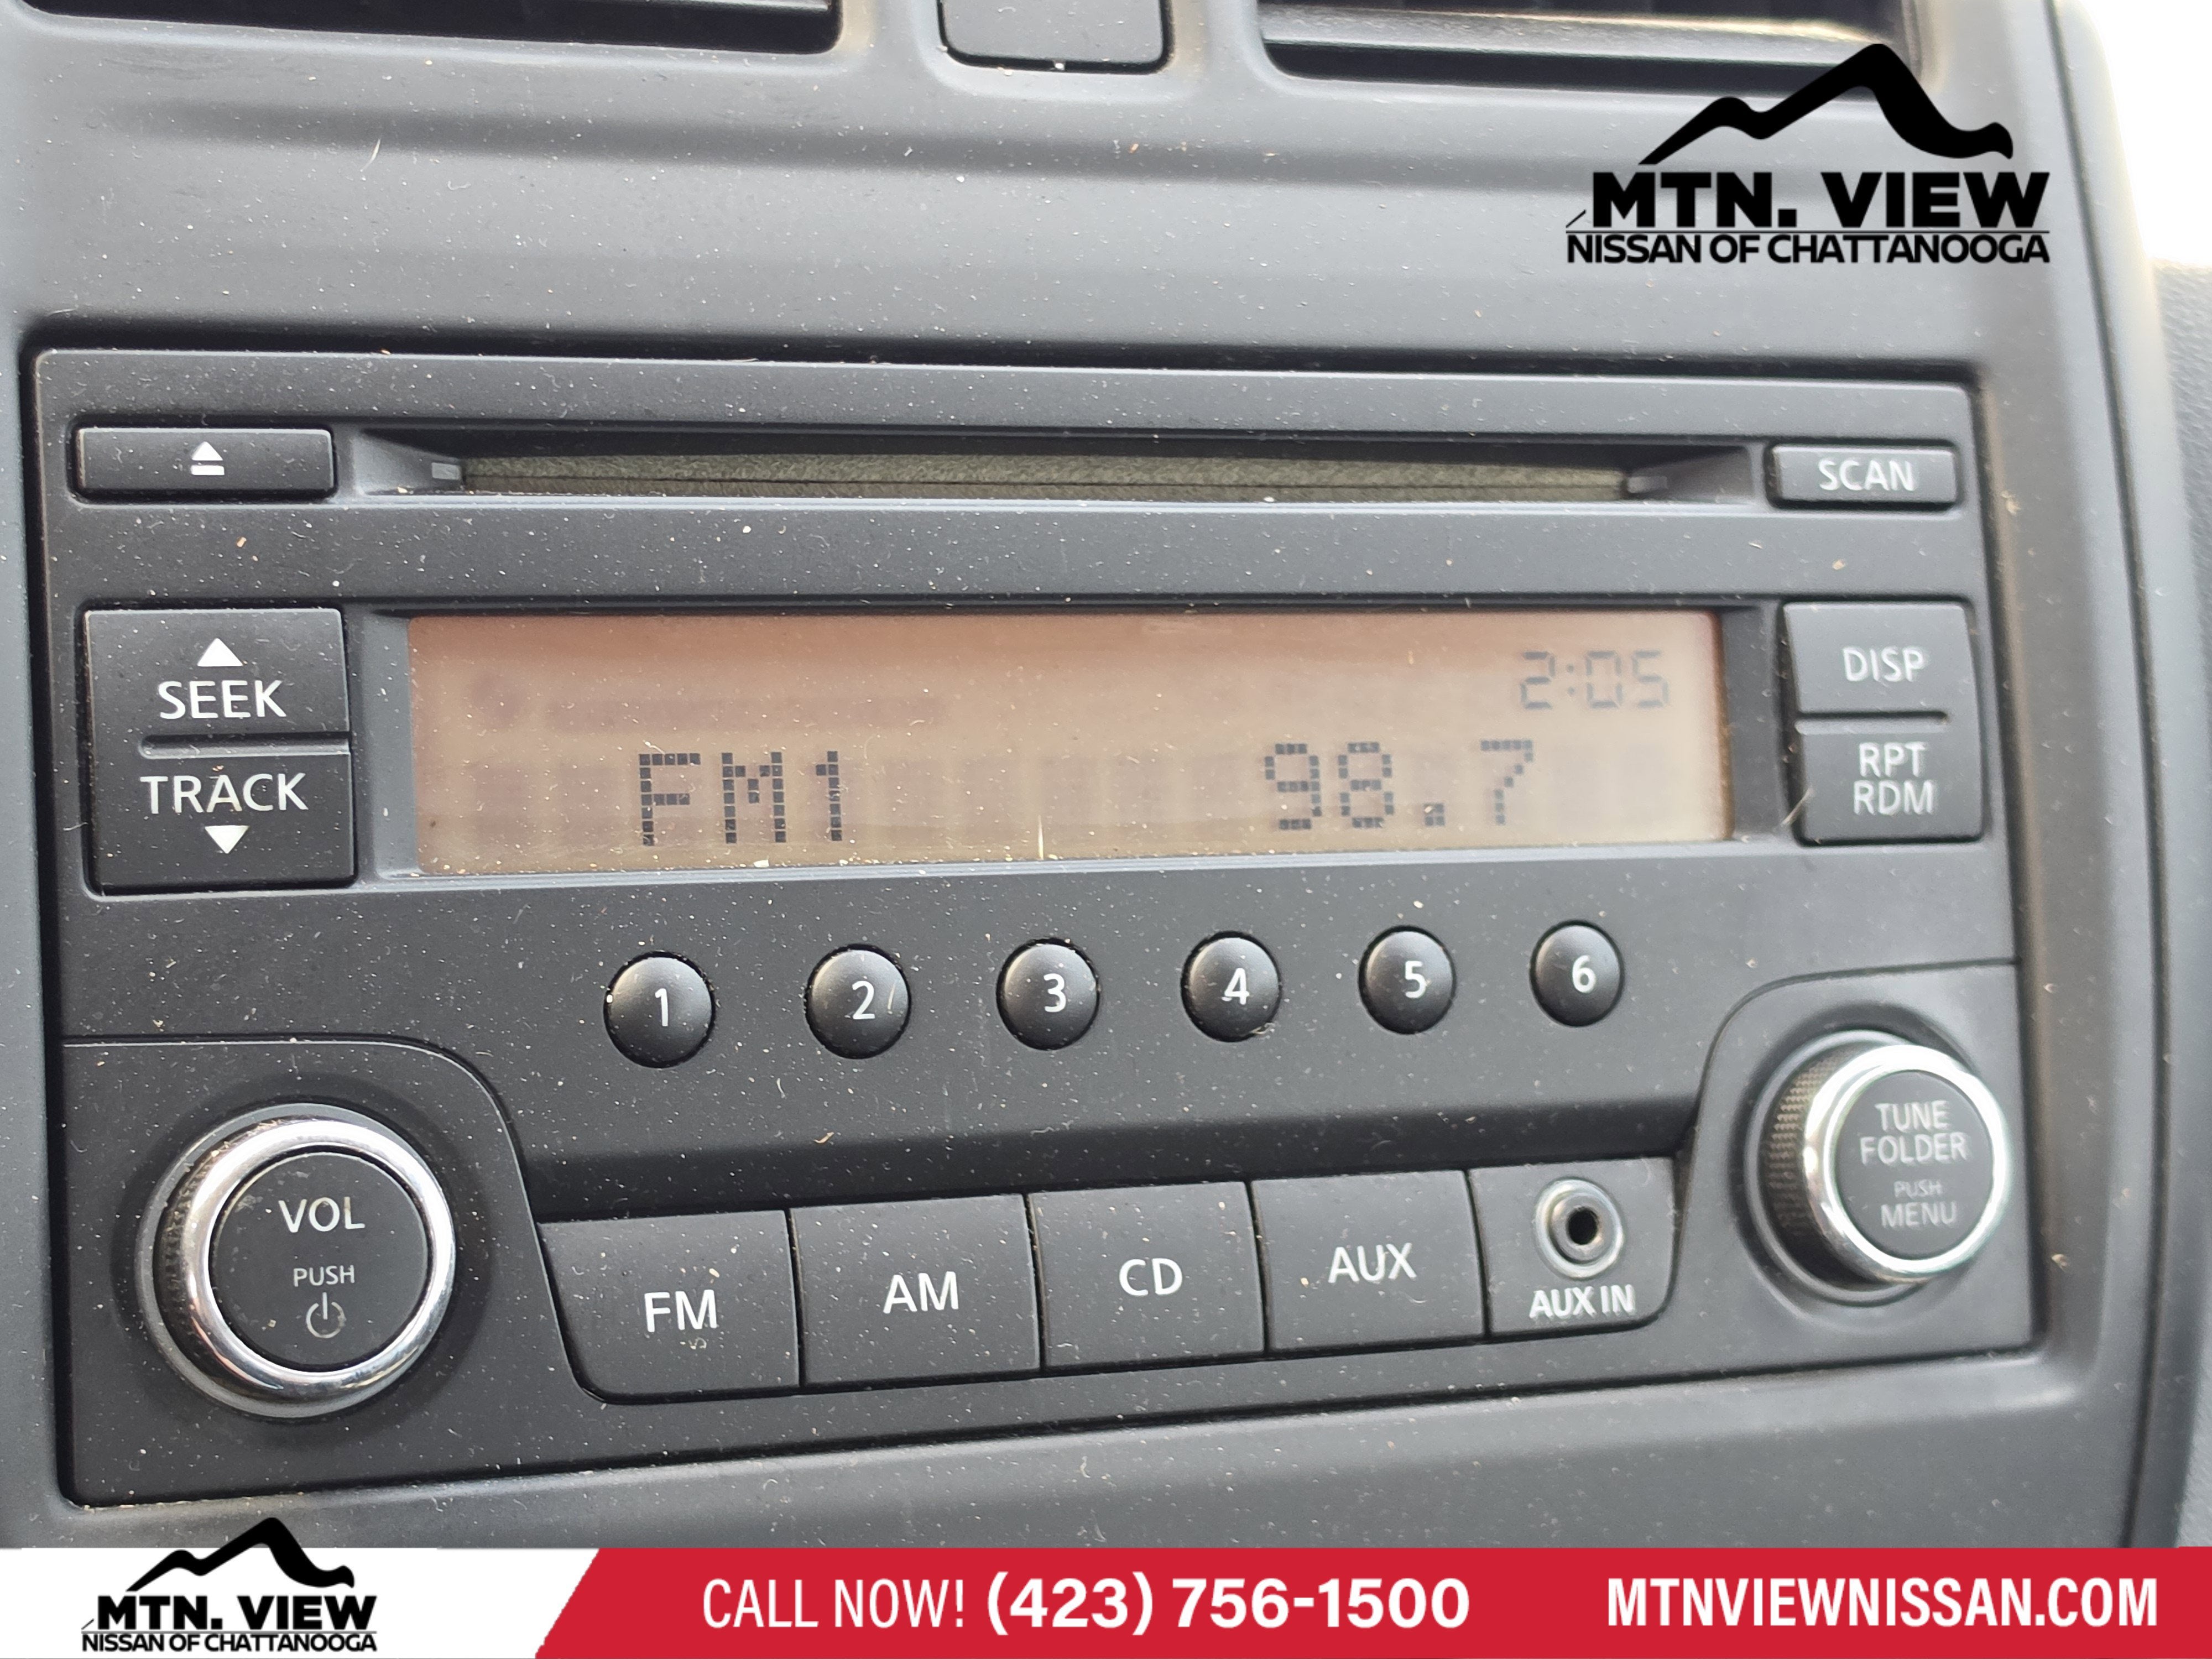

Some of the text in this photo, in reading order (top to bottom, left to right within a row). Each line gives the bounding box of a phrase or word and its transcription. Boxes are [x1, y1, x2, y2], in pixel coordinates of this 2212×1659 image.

[1818, 460, 1916, 491] SCAN
[1520, 651, 1668, 709] 2:05
[1843, 646, 1928, 683] DISP
[157, 680, 287, 719] SEEK
[1859, 742, 1927, 777] RPT
[140, 773, 309, 815] TRACK
[639, 739, 1533, 846] FM1 98.7
[1854, 781, 1934, 815] RDM
[1043, 973, 1066, 1013] 3
[1223, 967, 1249, 1005] 4
[1404, 961, 1428, 999] 5
[1572, 955, 1596, 993] 6
[655, 988, 669, 1027] 1
[852, 980, 875, 1020] 2
[1875, 1100, 1949, 1132] TUNE
[1860, 1132, 1968, 1165] FOLDER
[1894, 1180, 1942, 1198] PUSH
[279, 1196, 366, 1233] VOL
[1881, 1201, 1957, 1227] MENU
[293, 1265, 355, 1287] PUSH
[1119, 1258, 1183, 1297] CD
[1327, 1243, 1417, 1284] AUX
[644, 1289, 718, 1332] FM
[883, 1271, 959, 1313] AM
[1528, 1284, 1635, 1319] AUX IN
